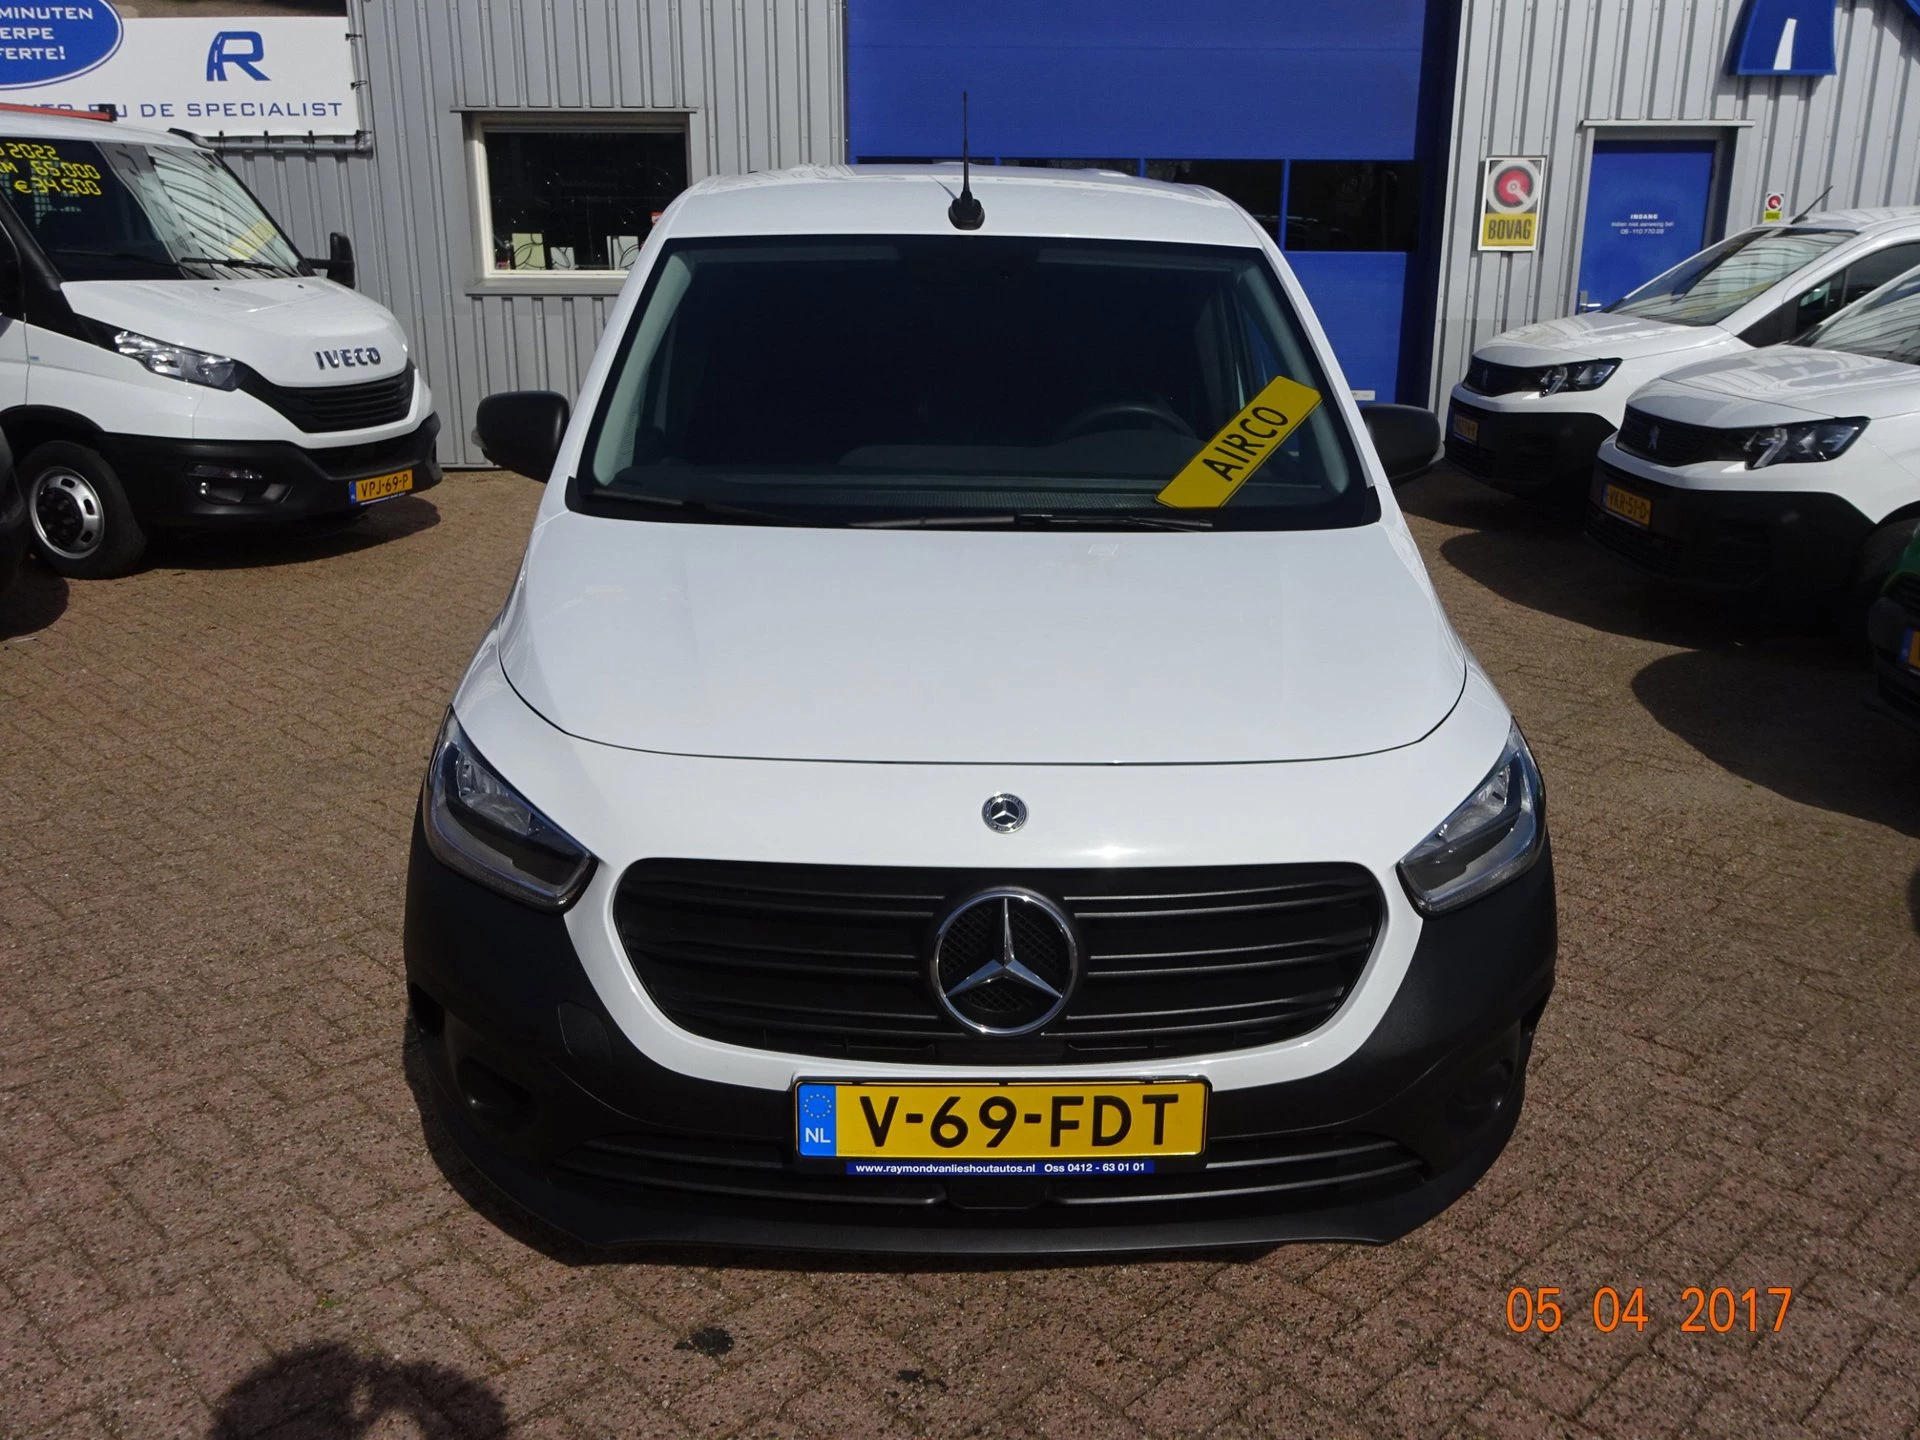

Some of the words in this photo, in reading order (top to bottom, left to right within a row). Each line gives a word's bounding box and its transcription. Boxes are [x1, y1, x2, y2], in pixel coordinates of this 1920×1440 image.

[0, 7, 93, 19] MINUTEN
[141, 104, 175, 117] DE
[187, 102, 343, 117] SPECIALIST
[5, 143, 60, 160] 2022
[30, 161, 101, 180] 65.000
[1488, 218, 1532, 239] BOVAG
[313, 347, 381, 370] IVECO
[1202, 406, 1289, 482] AIRCO
[859, 1094, 1179, 1148] V-69-FDT
[805, 1127, 831, 1143] NL
[856, 1164, 1035, 1174] www.raymondvanlieshoutautos.nl
[1044, 1164, 1065, 1172] Oss
[1067, 1163, 1093, 1172] 0412
[1102, 1163, 1115, 1172] 63
[1118, 1163, 1130, 1172] 01
[1133, 1163, 1145, 1172] 01
